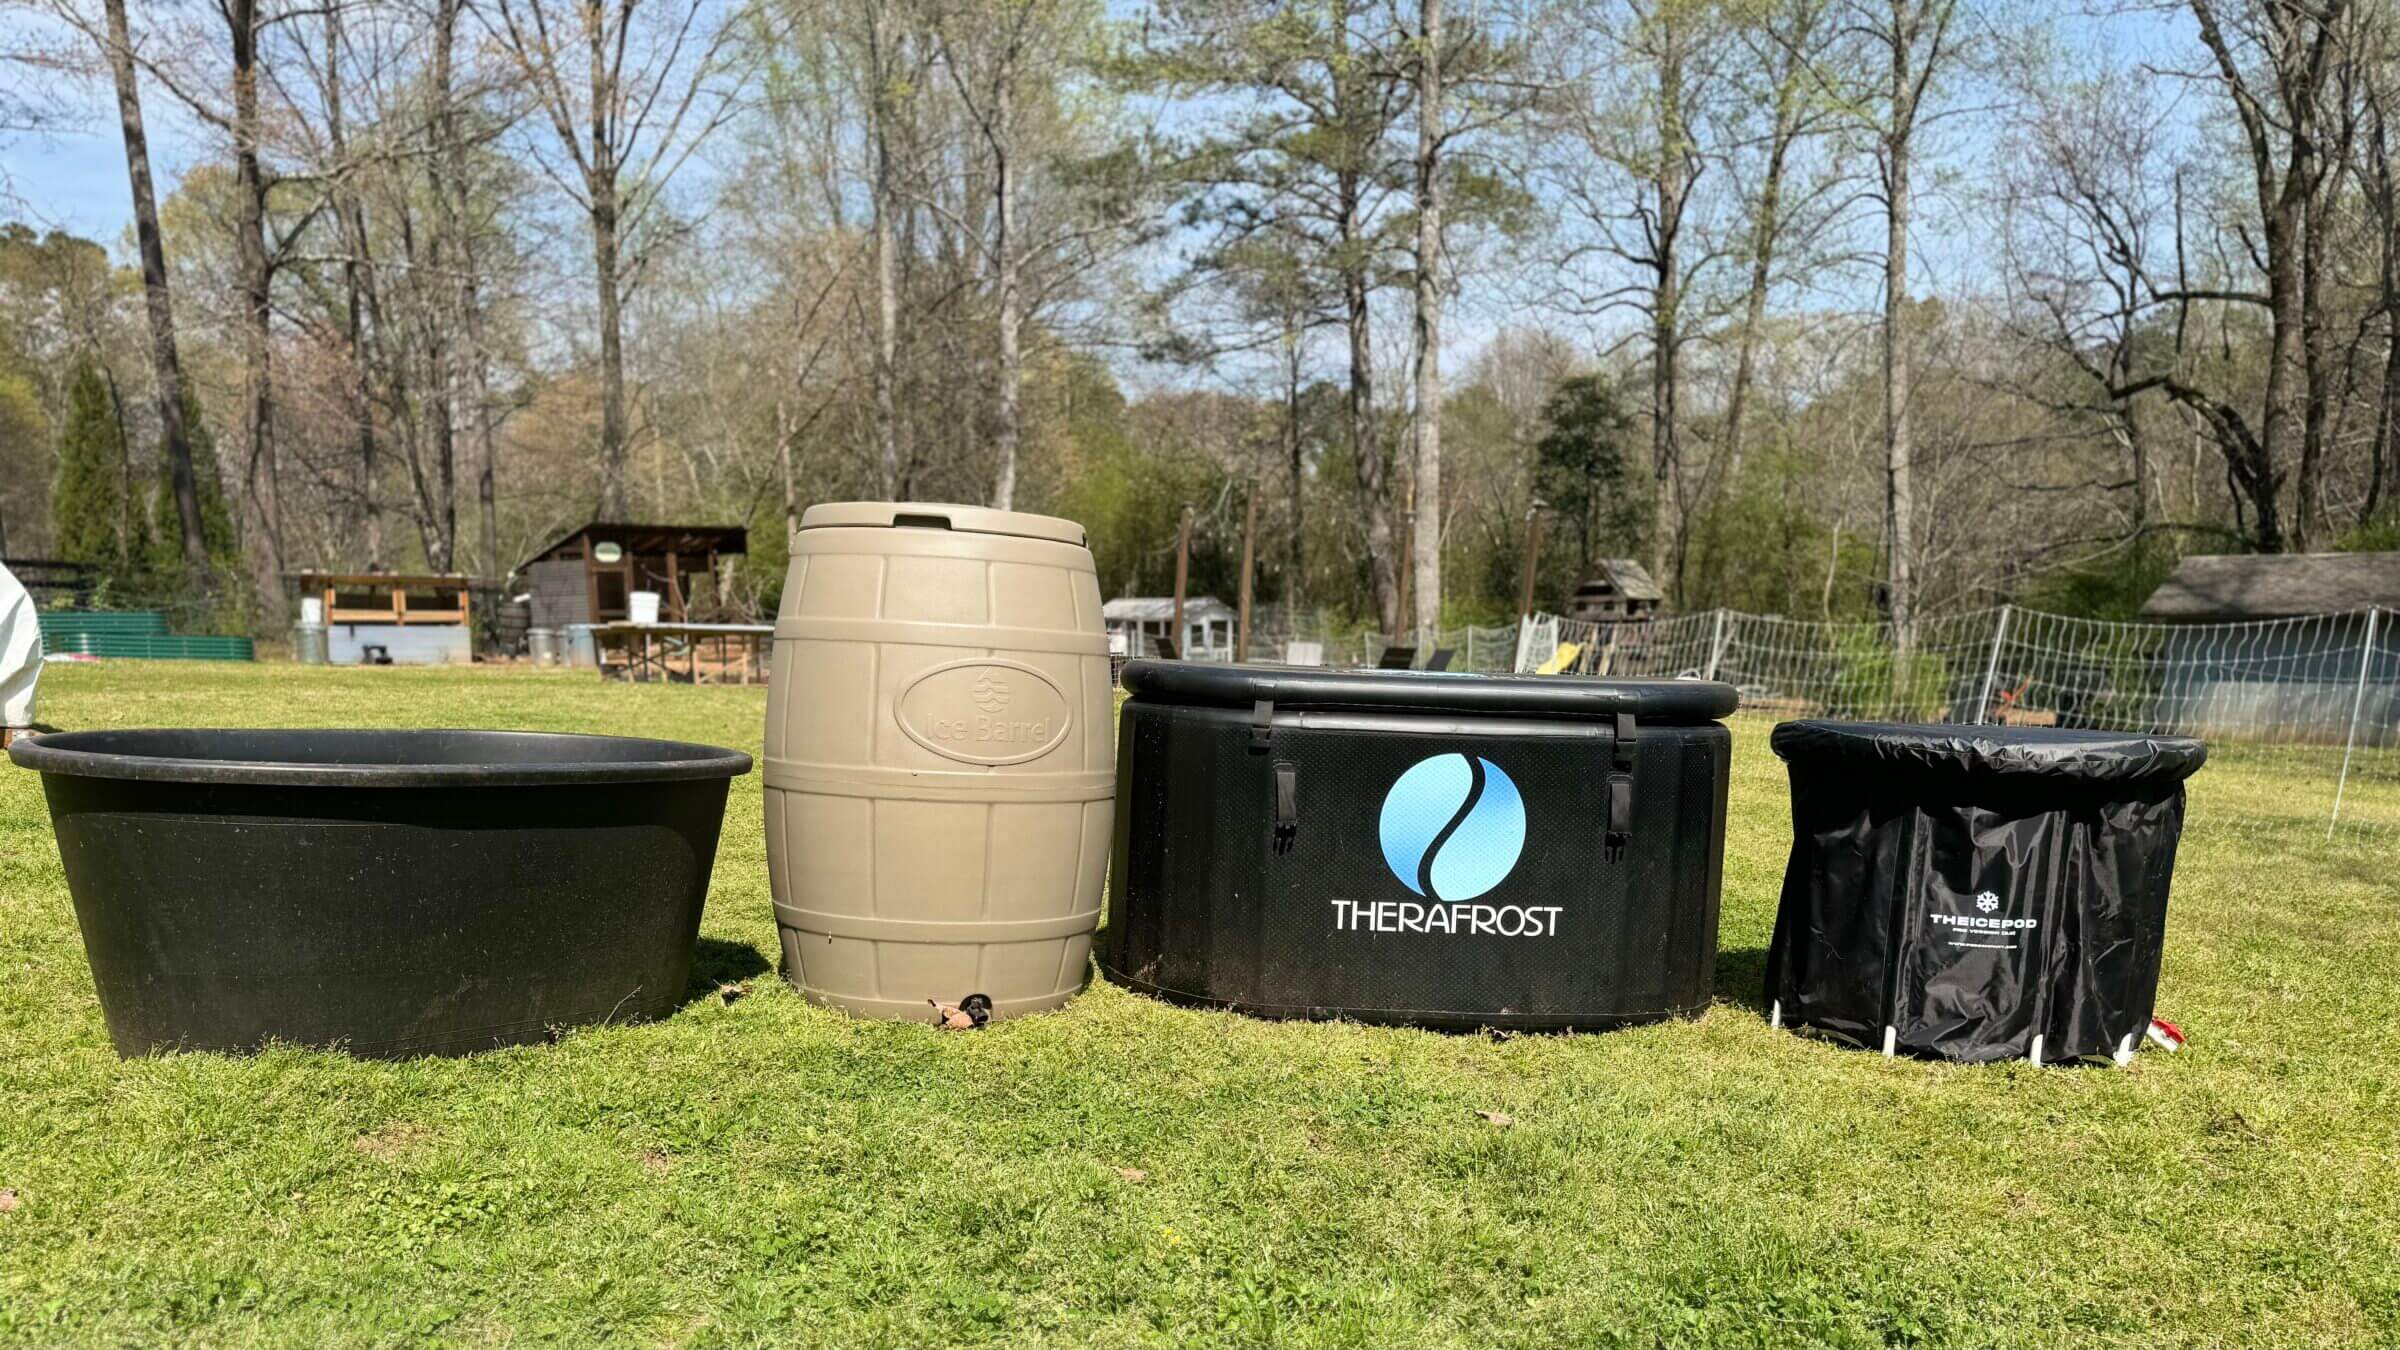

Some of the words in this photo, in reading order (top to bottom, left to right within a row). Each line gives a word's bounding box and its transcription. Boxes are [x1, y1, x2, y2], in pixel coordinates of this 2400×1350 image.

[927, 713, 969, 741] Ice
[975, 714, 1051, 744] Barrel
[1331, 899, 1564, 937] THERAFROST
[1930, 914, 2037, 929] THEICEPOD
